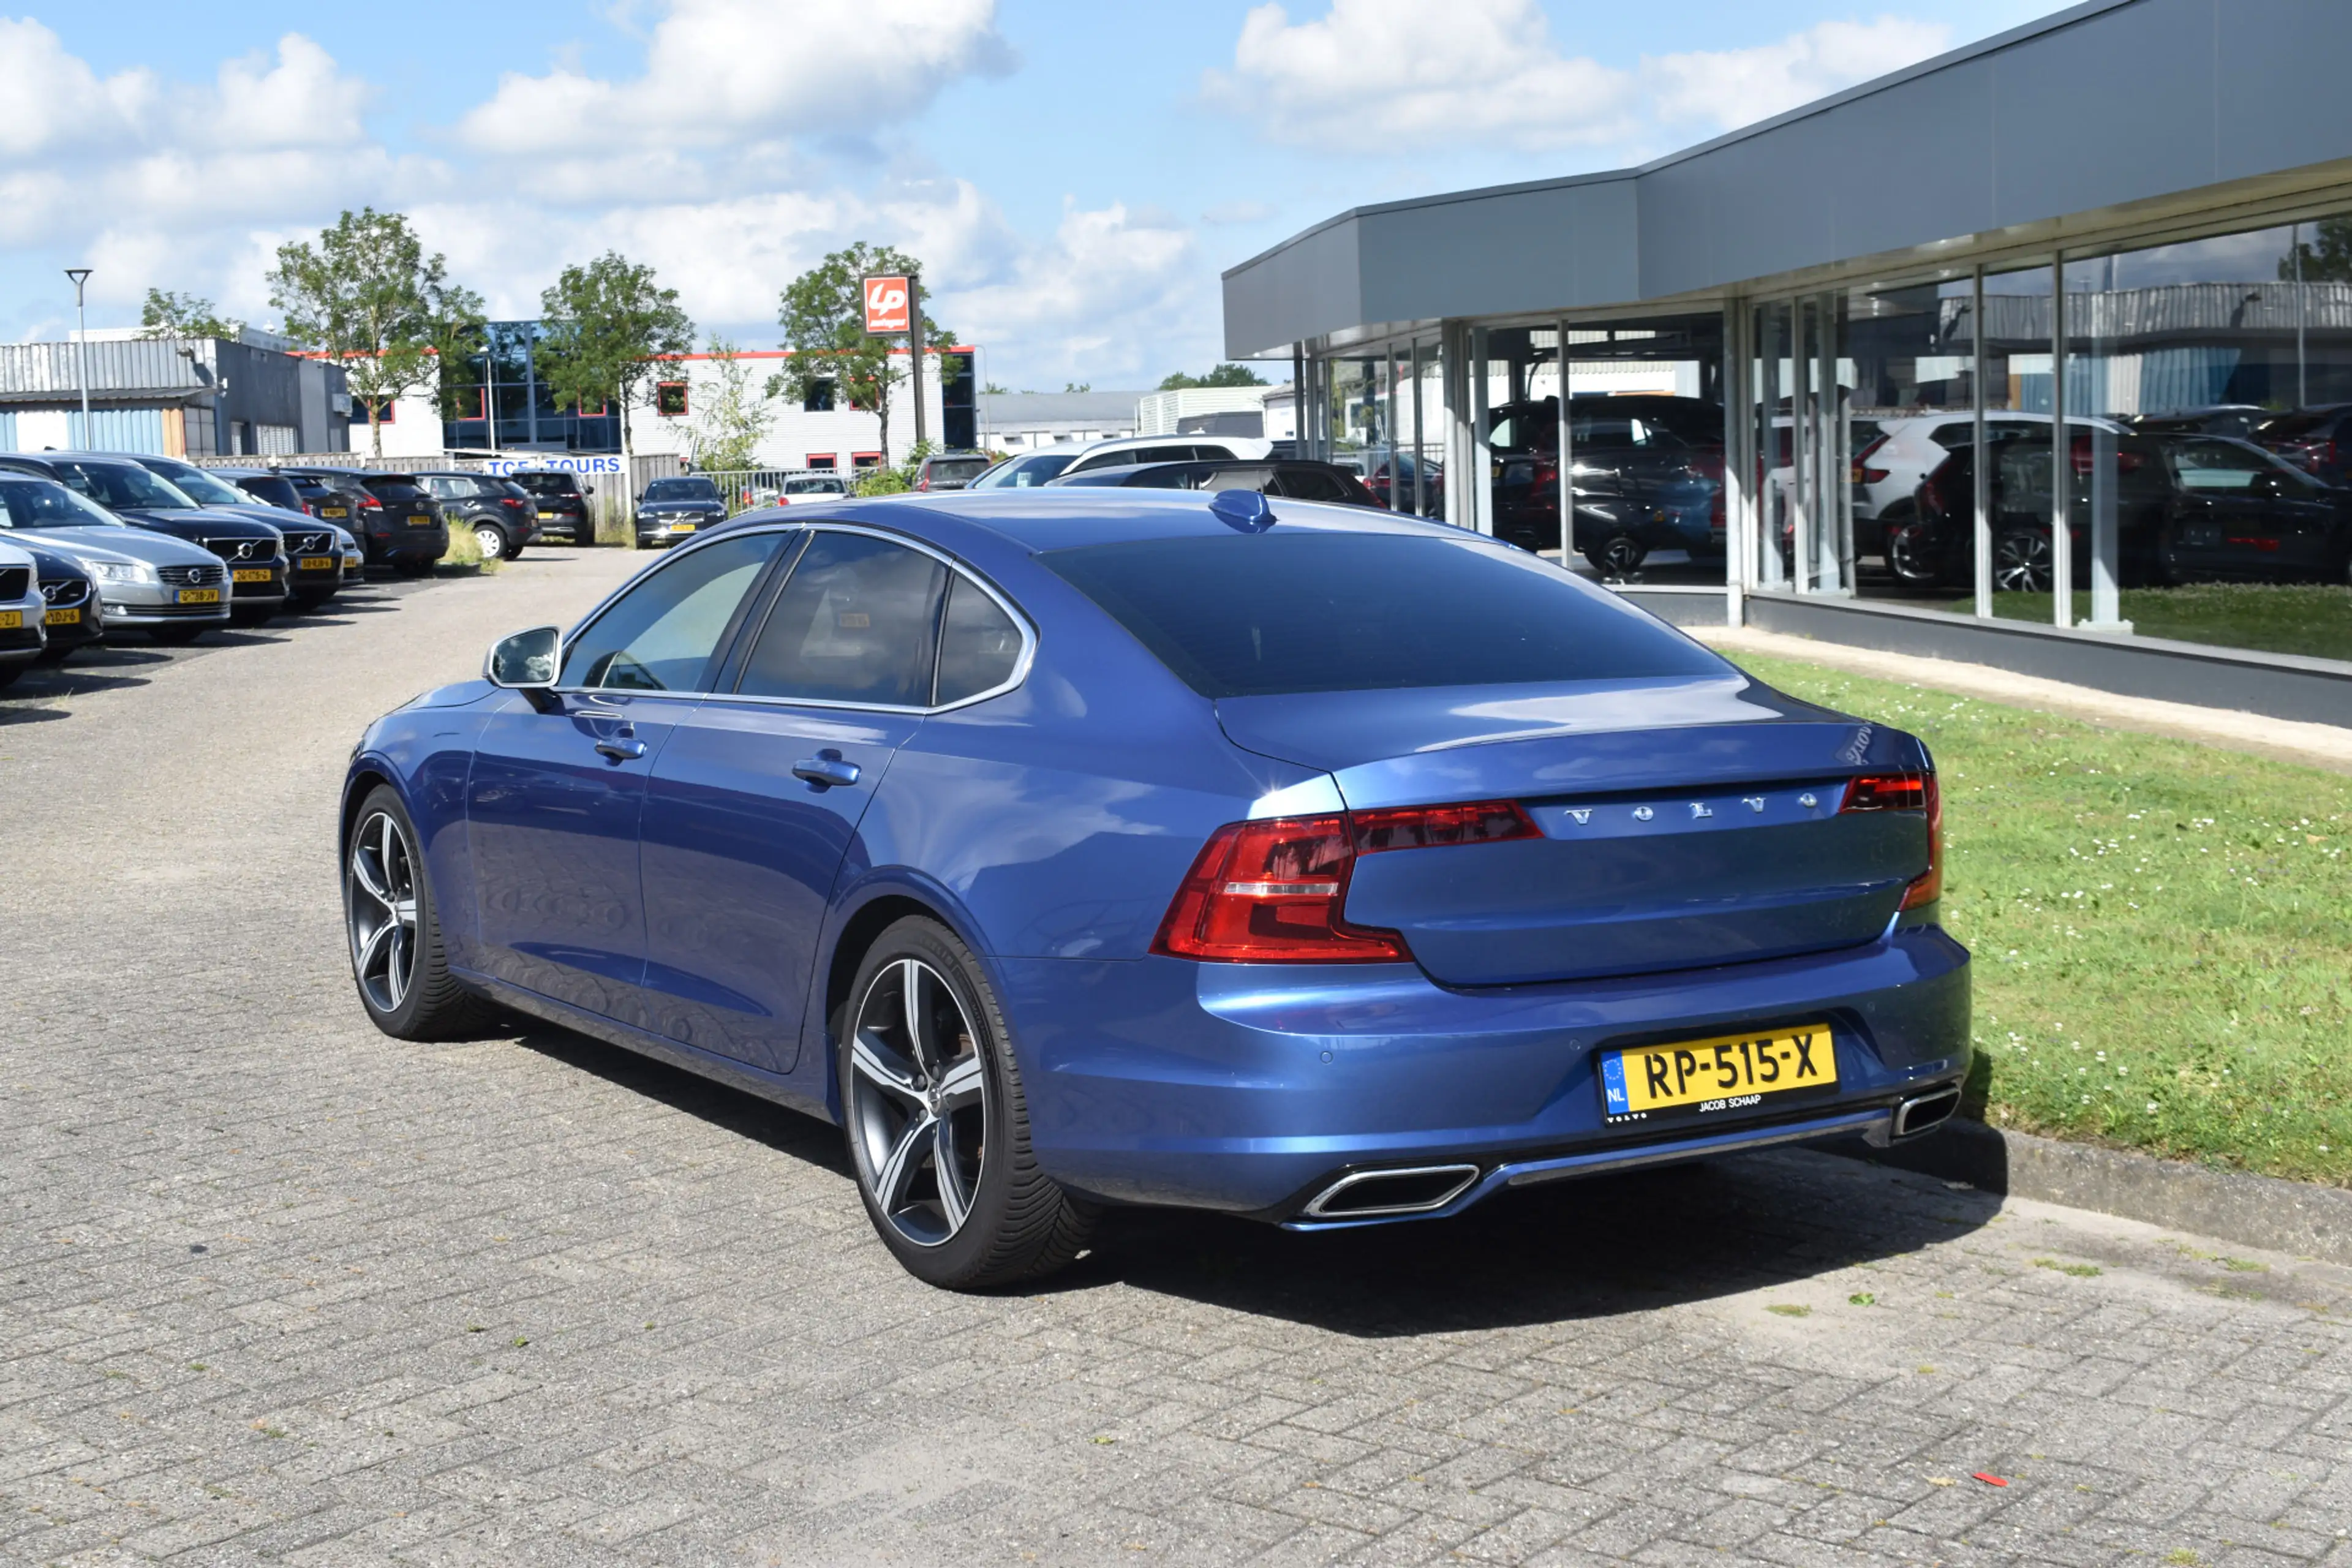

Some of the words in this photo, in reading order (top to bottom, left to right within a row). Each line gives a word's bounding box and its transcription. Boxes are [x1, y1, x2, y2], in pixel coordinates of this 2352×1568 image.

[546, 457, 619, 473] TOURS
[1564, 793, 1817, 825] VOLVO
[1644, 1033, 1818, 1099] RP-515-X
[1607, 1087, 1625, 1102] NL
[1698, 1099, 1727, 1112] JACOB
[1728, 1094, 1762, 1108] SCHAAP
[1607, 1112, 1647, 1123] VOLVO
